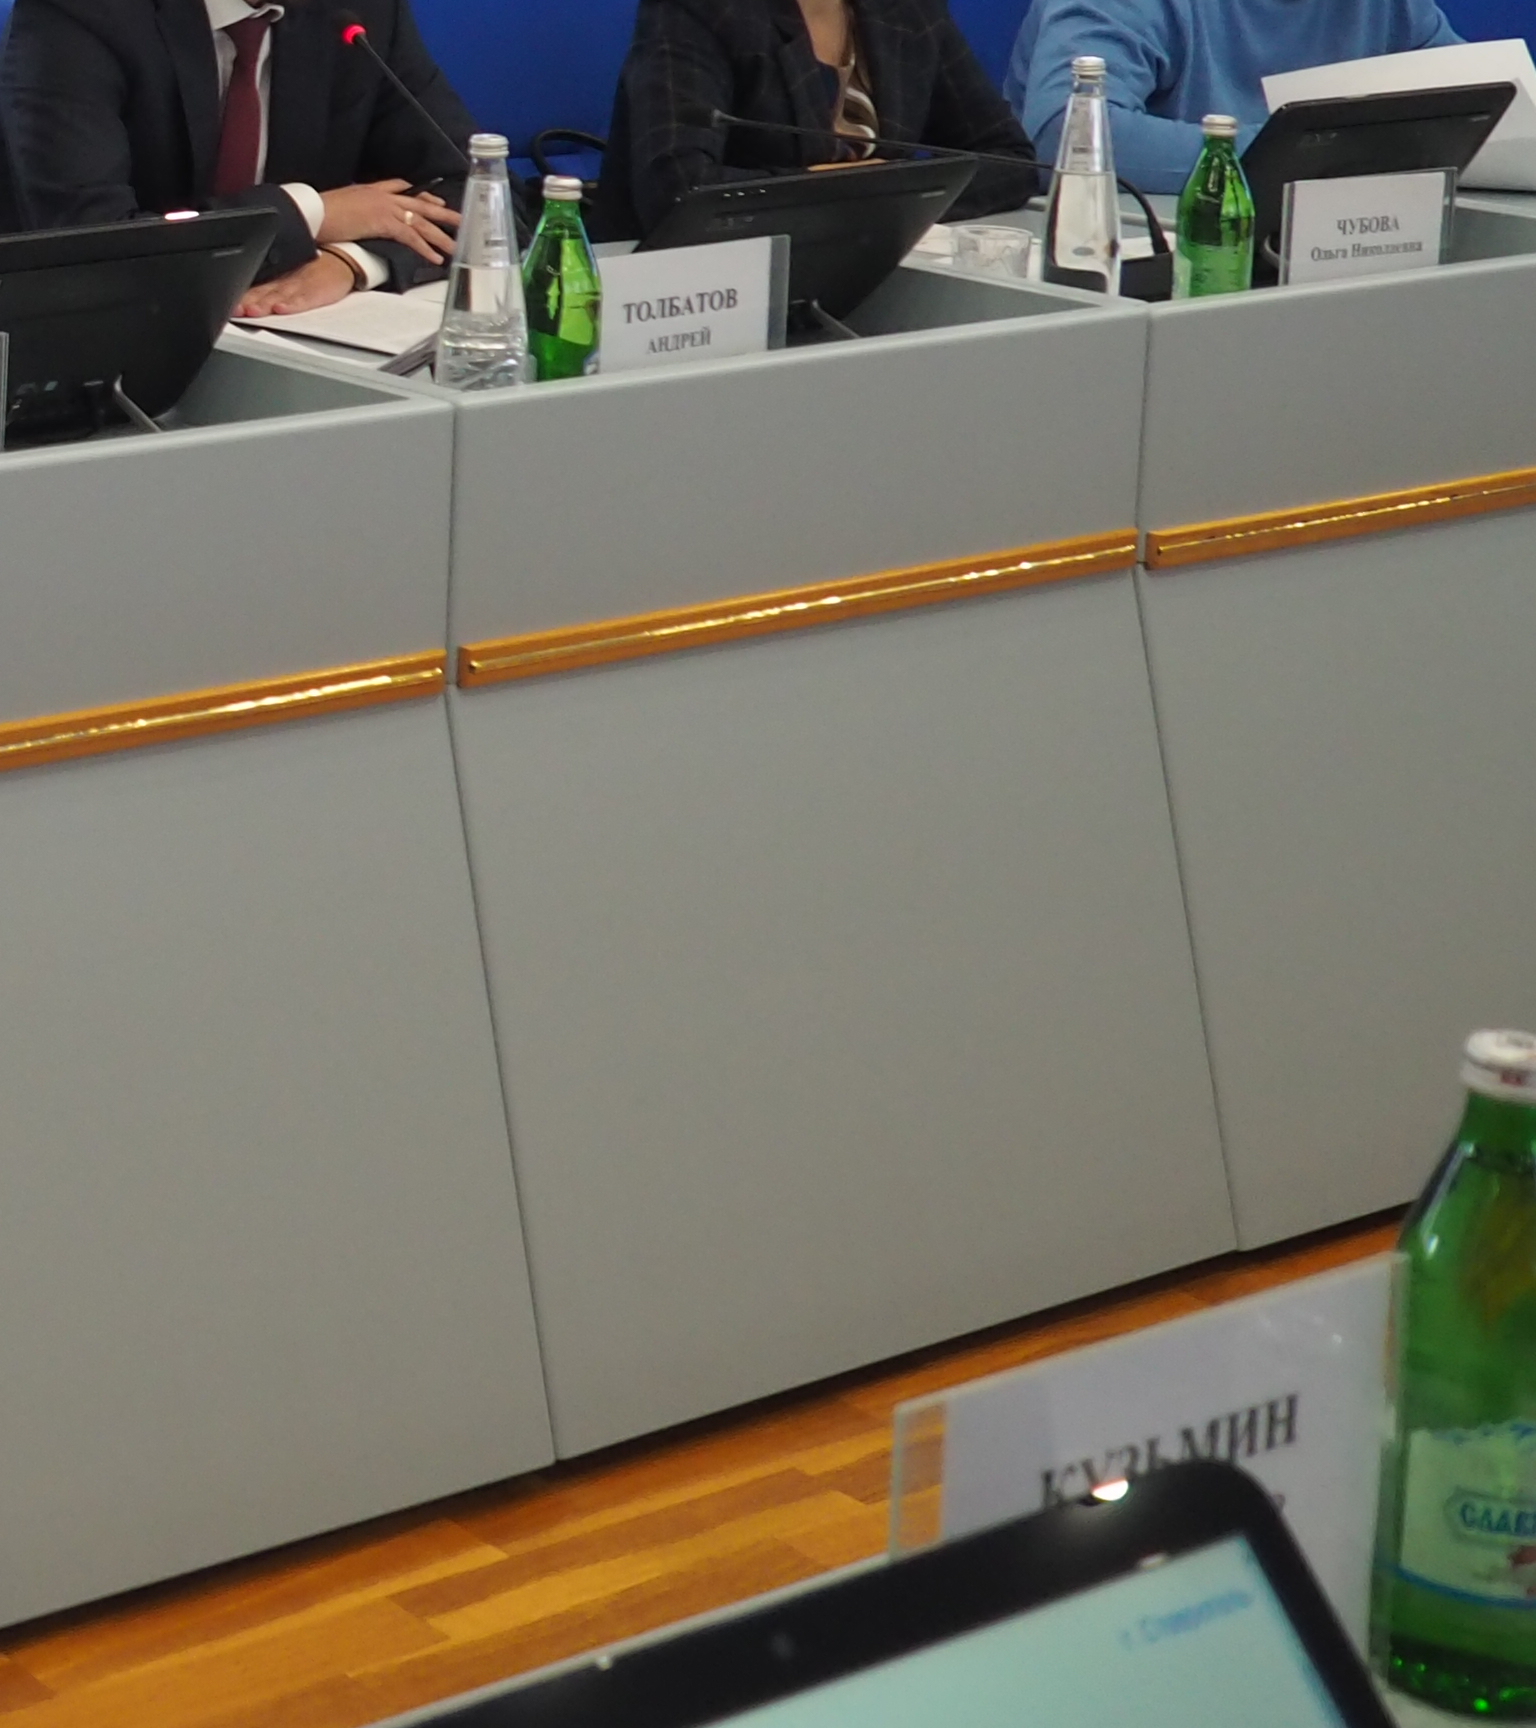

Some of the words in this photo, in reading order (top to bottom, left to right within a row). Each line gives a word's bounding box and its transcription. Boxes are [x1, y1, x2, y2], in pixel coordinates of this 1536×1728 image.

[1336, 215, 1399, 235] ЧУБОВА
[1311, 246, 1347, 261] Ольга
[623, 288, 738, 323] ТОЛБАТОВ
[647, 326, 711, 354] АНДРЕЙ
